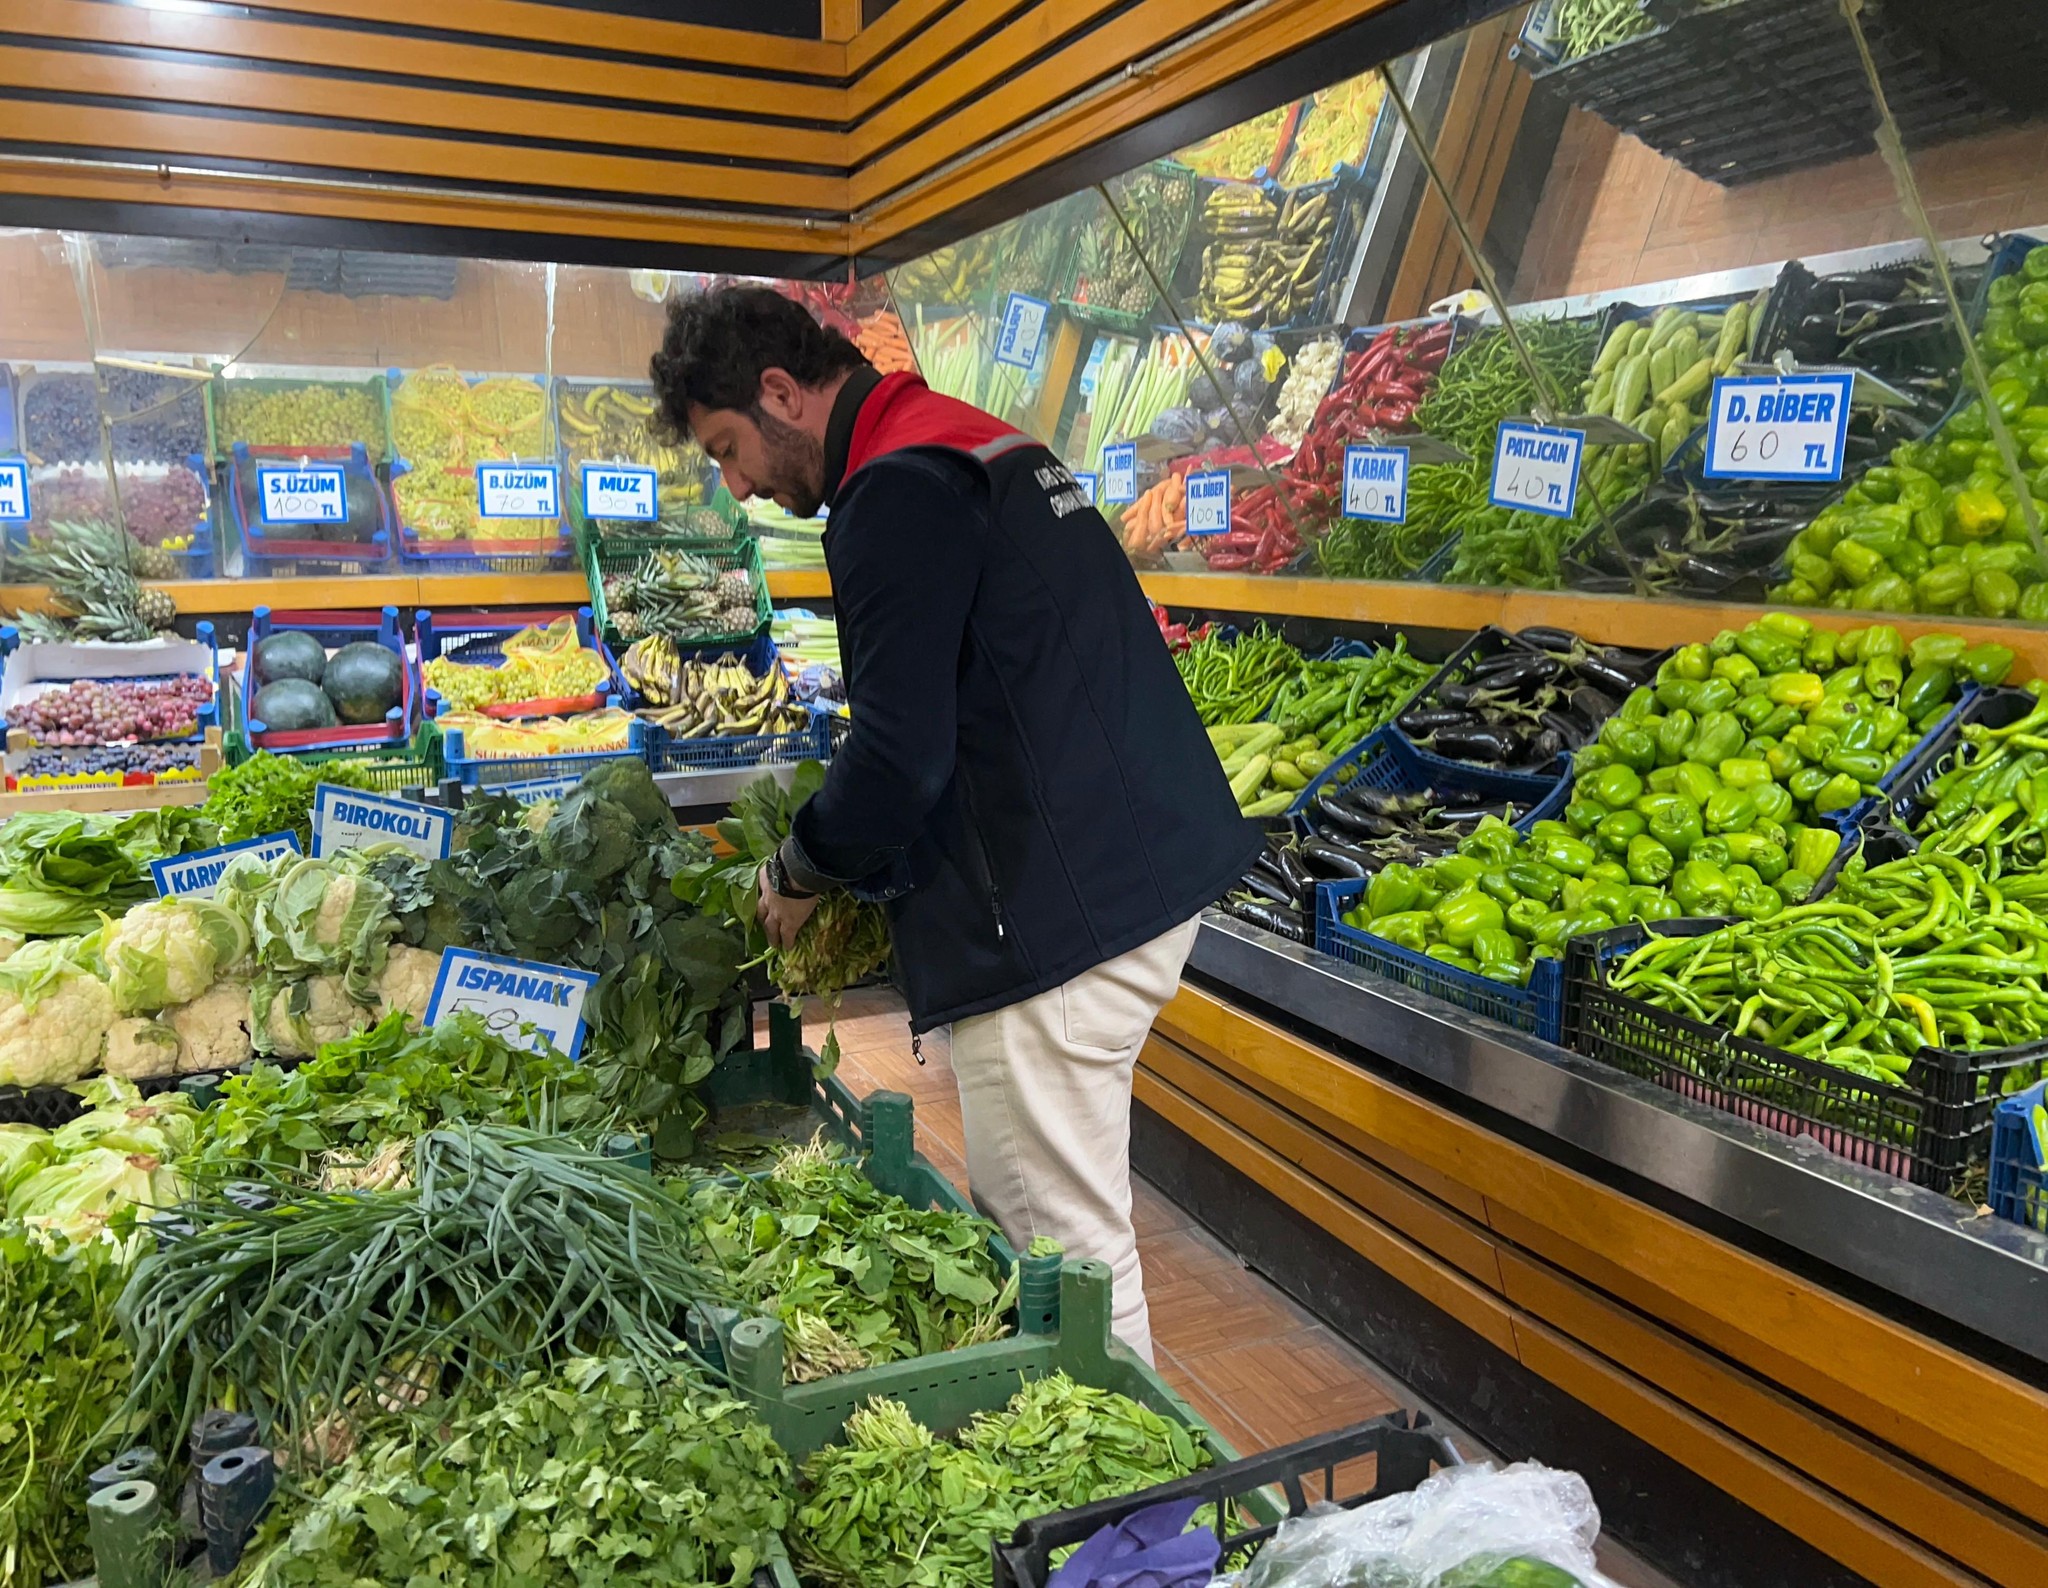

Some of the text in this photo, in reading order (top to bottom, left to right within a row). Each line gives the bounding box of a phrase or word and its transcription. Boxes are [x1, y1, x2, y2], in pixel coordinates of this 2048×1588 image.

[1727, 388, 1836, 423] D. BİBER
[1506, 436, 1569, 464] PATLICAN
[1731, 429, 1828, 468] 60 TL
[489, 470, 547, 489] B.ÜZÜM
[1352, 457, 1397, 482] KABAK
[271, 473, 335, 494] S.ÜZÜM
[599, 476, 641, 493] MUZ
[1108, 477, 1124, 494] 100
[1126, 480, 1133, 495] TL
[1203, 479, 1224, 498] BİBER
[1507, 467, 1562, 505] 40 TL
[0, 500, 16, 513] TL
[274, 496, 336, 517] 100 TL
[496, 494, 551, 512] 70 TL
[599, 494, 649, 514] 90 TL
[1350, 483, 1396, 513] 40 TL
[1190, 506, 1225, 525] 100 TL
[333, 800, 432, 841] BIROKOLİ
[456, 965, 575, 1007] ISPANAK
